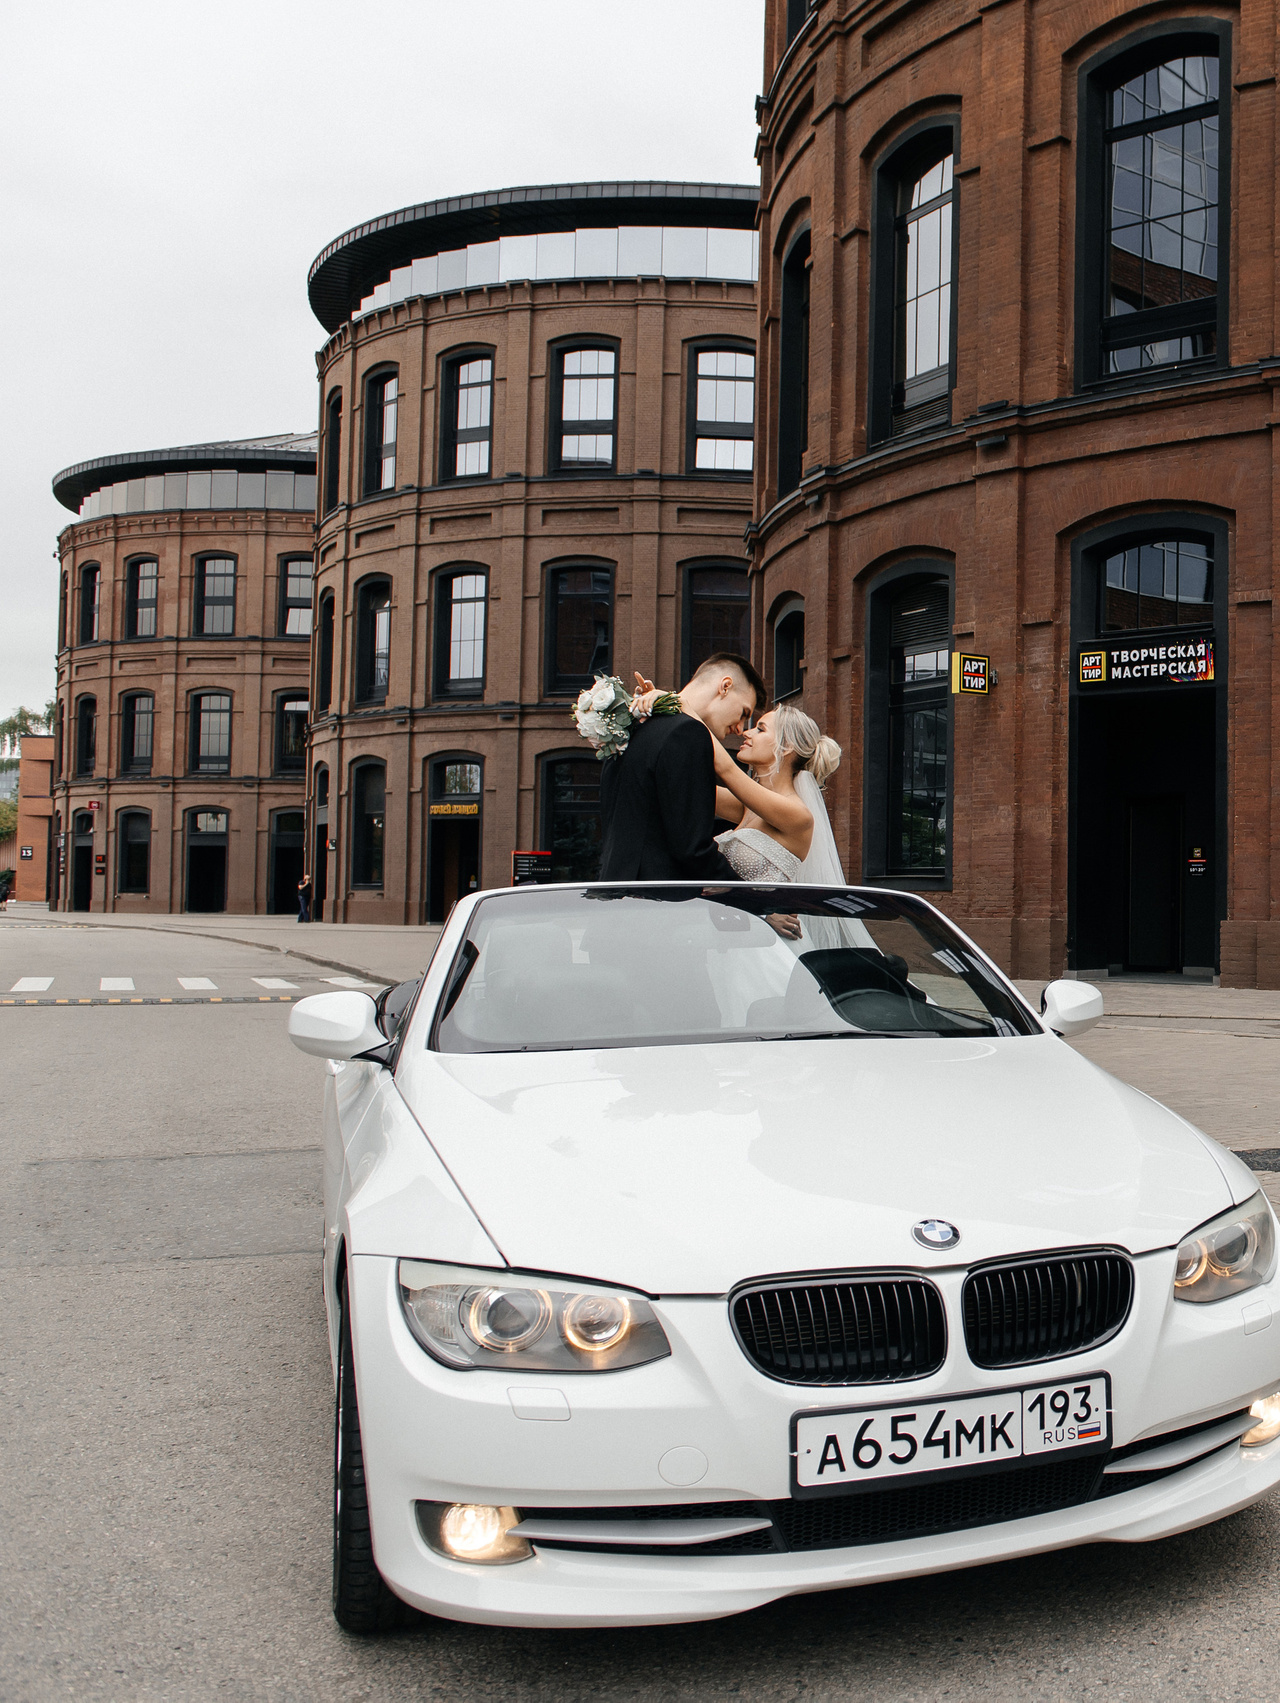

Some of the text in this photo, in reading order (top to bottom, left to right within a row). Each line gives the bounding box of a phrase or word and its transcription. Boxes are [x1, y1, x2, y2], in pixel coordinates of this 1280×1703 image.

[1082, 655, 1101, 667] АРТ
[1111, 643, 1206, 663] ТВОРЧЕСКАЯ
[963, 660, 986, 674] АРТ
[1082, 668, 1102, 679] ТИР
[1111, 659, 1206, 679] МАСТЕРСКАЯ
[963, 675, 986, 689] ТИР
[1027, 1385, 1091, 1431] 193
[1043, 1426, 1076, 1445] RUS
